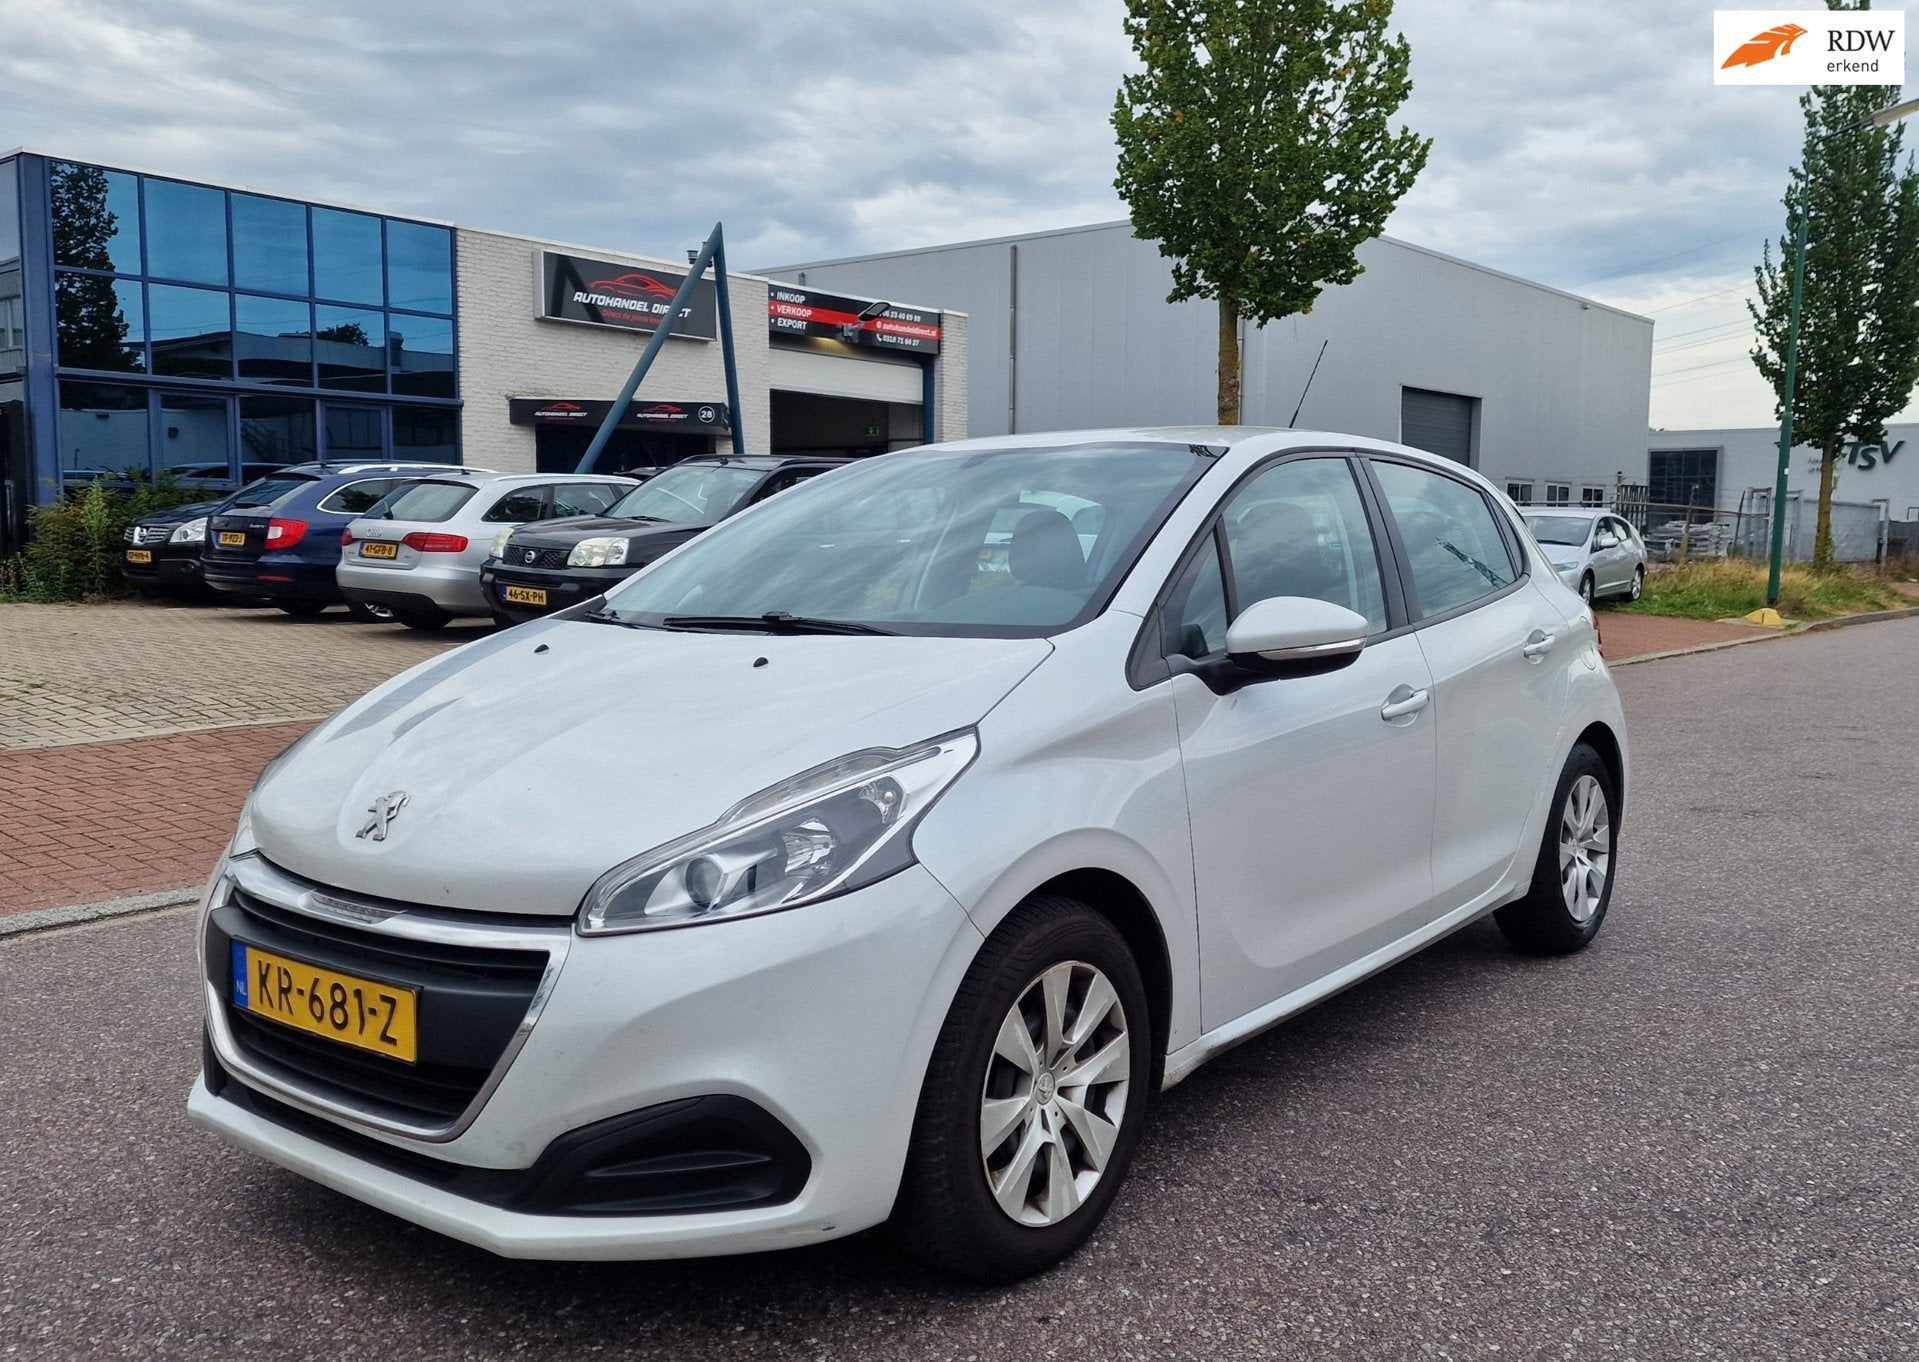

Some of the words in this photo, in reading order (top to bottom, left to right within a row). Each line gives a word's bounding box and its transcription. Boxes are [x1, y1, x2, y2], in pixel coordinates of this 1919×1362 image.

[573, 291, 649, 312] AUTOHANDEL
[651, 303, 692, 318] DIRT
[777, 291, 806, 304] INKOOP
[777, 304, 812, 318] VERKOOP
[777, 317, 808, 330] EXPORT
[700, 410, 713, 419] 28
[1846, 440, 1906, 471] TSV
[508, 588, 544, 603] 46-SX-PH
[236, 980, 247, 997] NL
[257, 959, 398, 1046] KR-681-Z
